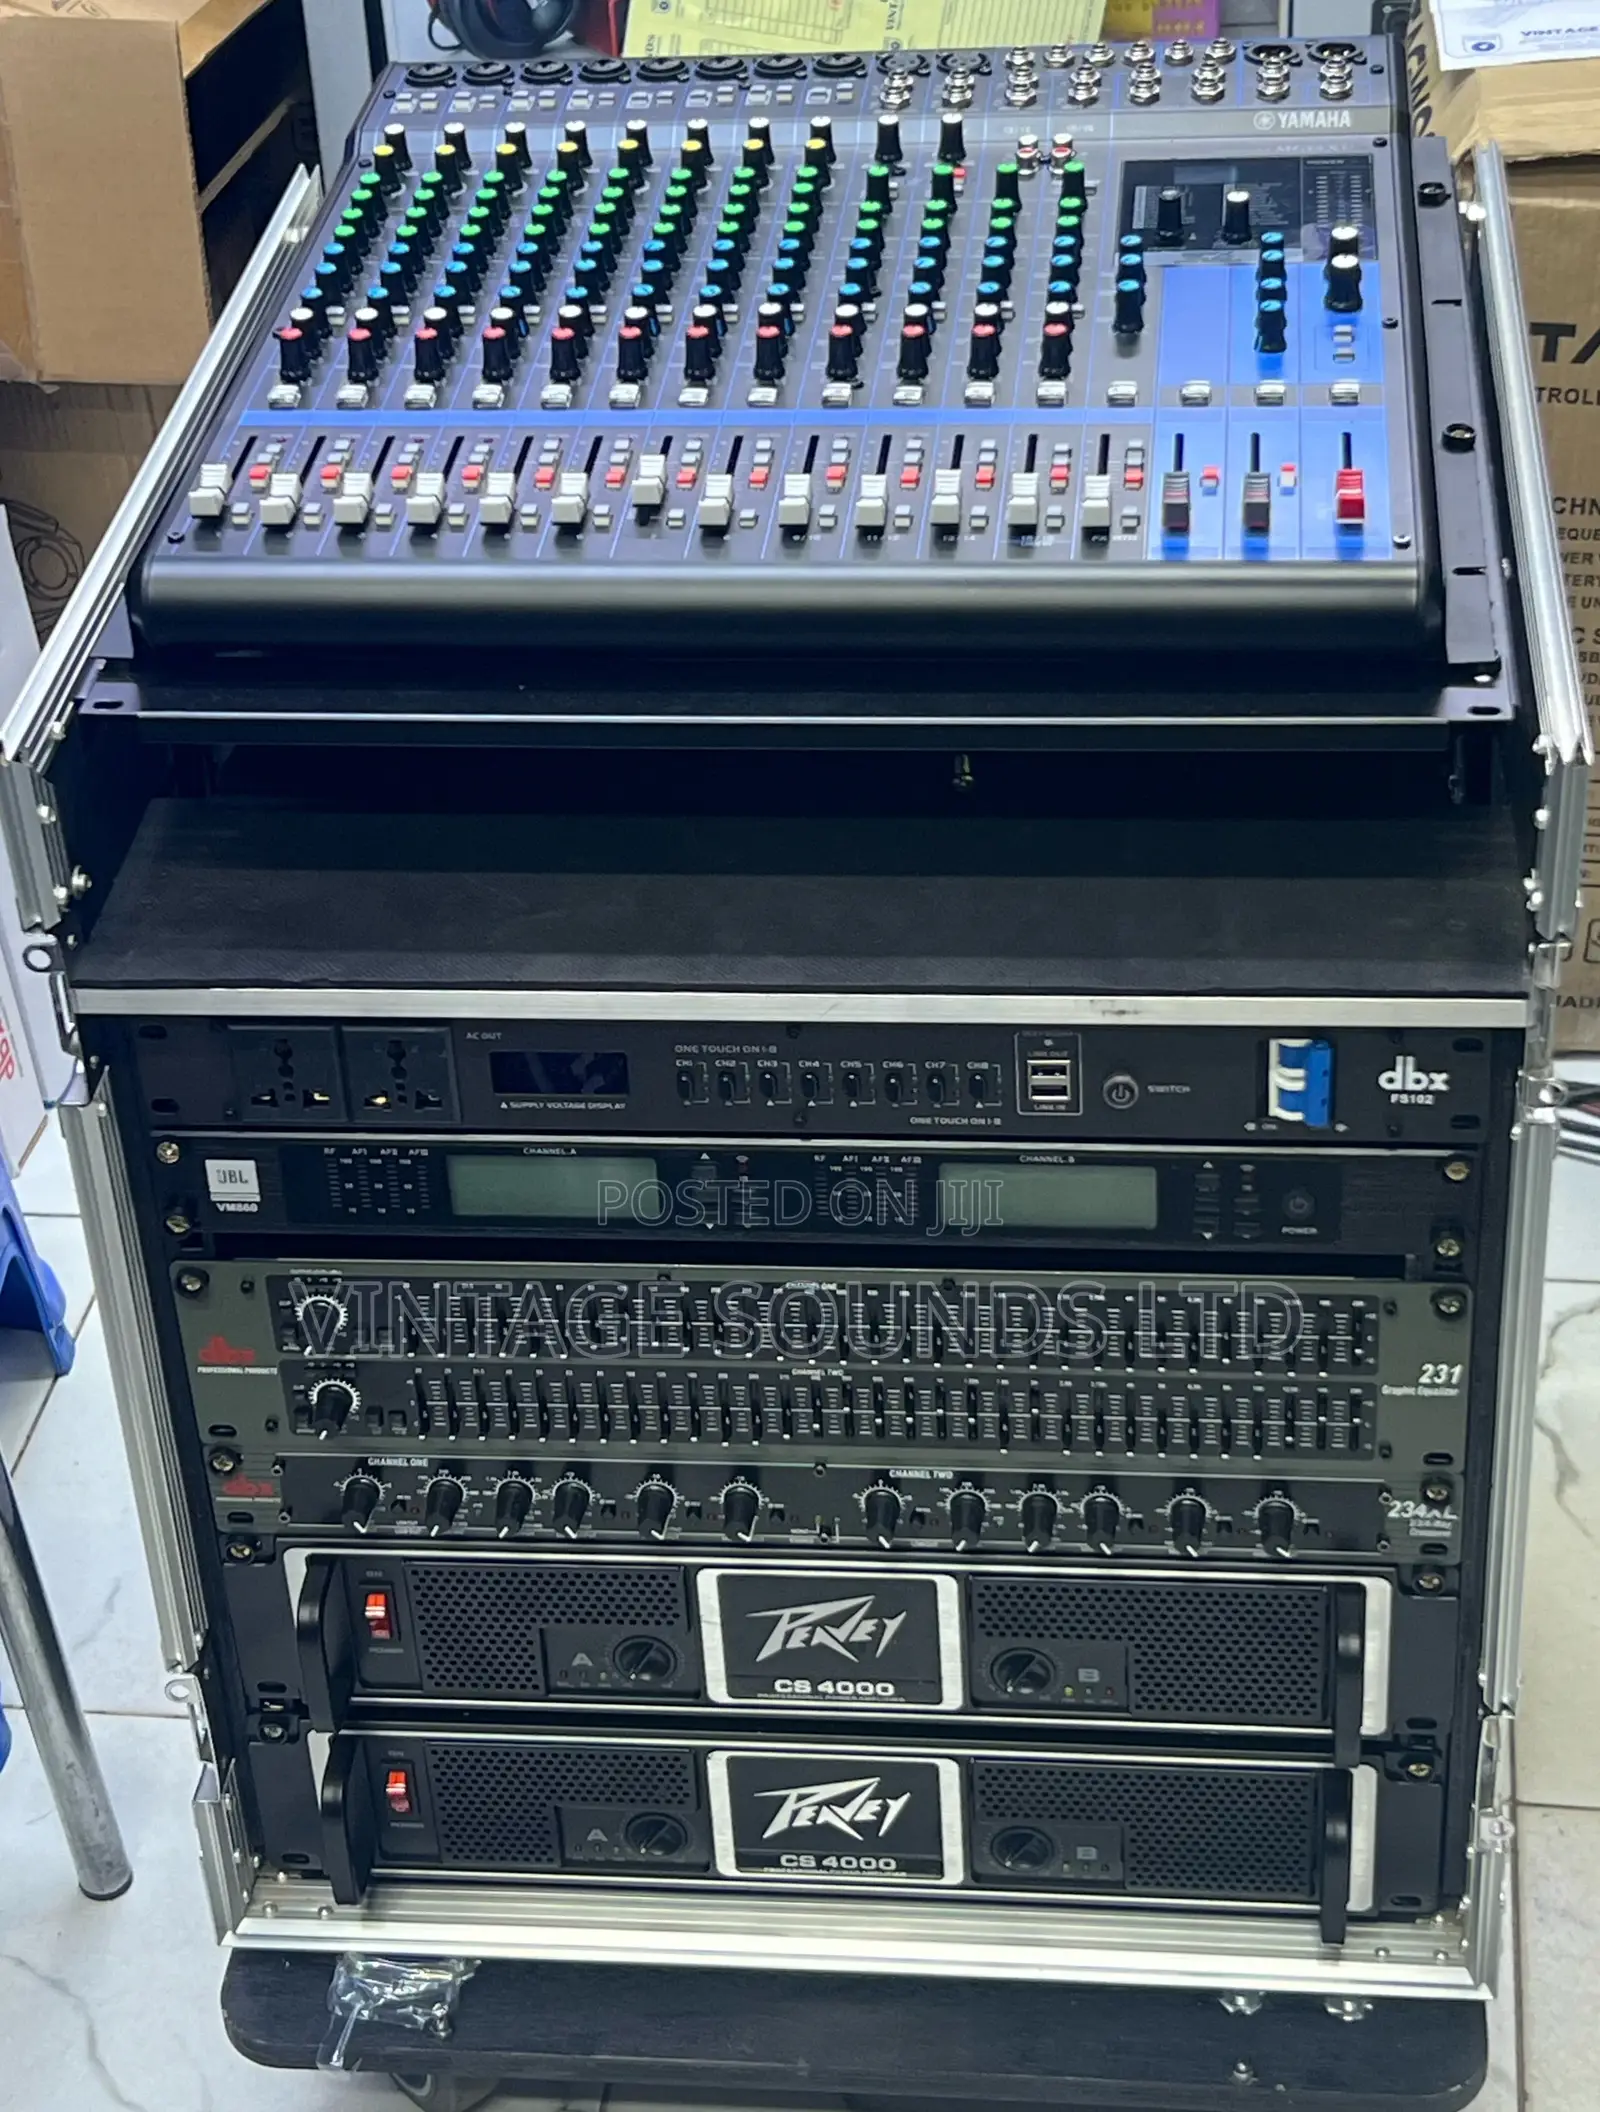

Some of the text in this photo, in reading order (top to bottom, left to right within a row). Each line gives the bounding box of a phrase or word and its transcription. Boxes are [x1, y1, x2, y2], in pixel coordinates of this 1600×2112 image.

[1277, 109, 1351, 129] YAMAHA
[675, 1045, 699, 1053] ONE
[701, 1045, 741, 1053] TOUCH
[925, 1061, 946, 1069] CH7
[1378, 1056, 1449, 1091] dbx
[910, 1116, 932, 1125] ONE
[934, 1116, 968, 1125] TOUCH
[216, 1168, 249, 1184] JBL
[1281, 1226, 1318, 1235] POWER
[1418, 1363, 1463, 1385] 231
[367, 1456, 428, 1467] CHANNEL ONE
[889, 1468, 954, 1479] CHANNEL TWO
[746, 1595, 907, 1663] PEAVEY
[572, 1653, 593, 1667] A
[774, 1679, 895, 1696] CS 4000
[754, 1777, 911, 1840] PEAVEY
[587, 1828, 608, 1842] A
[780, 1854, 897, 1870] CS 4000
